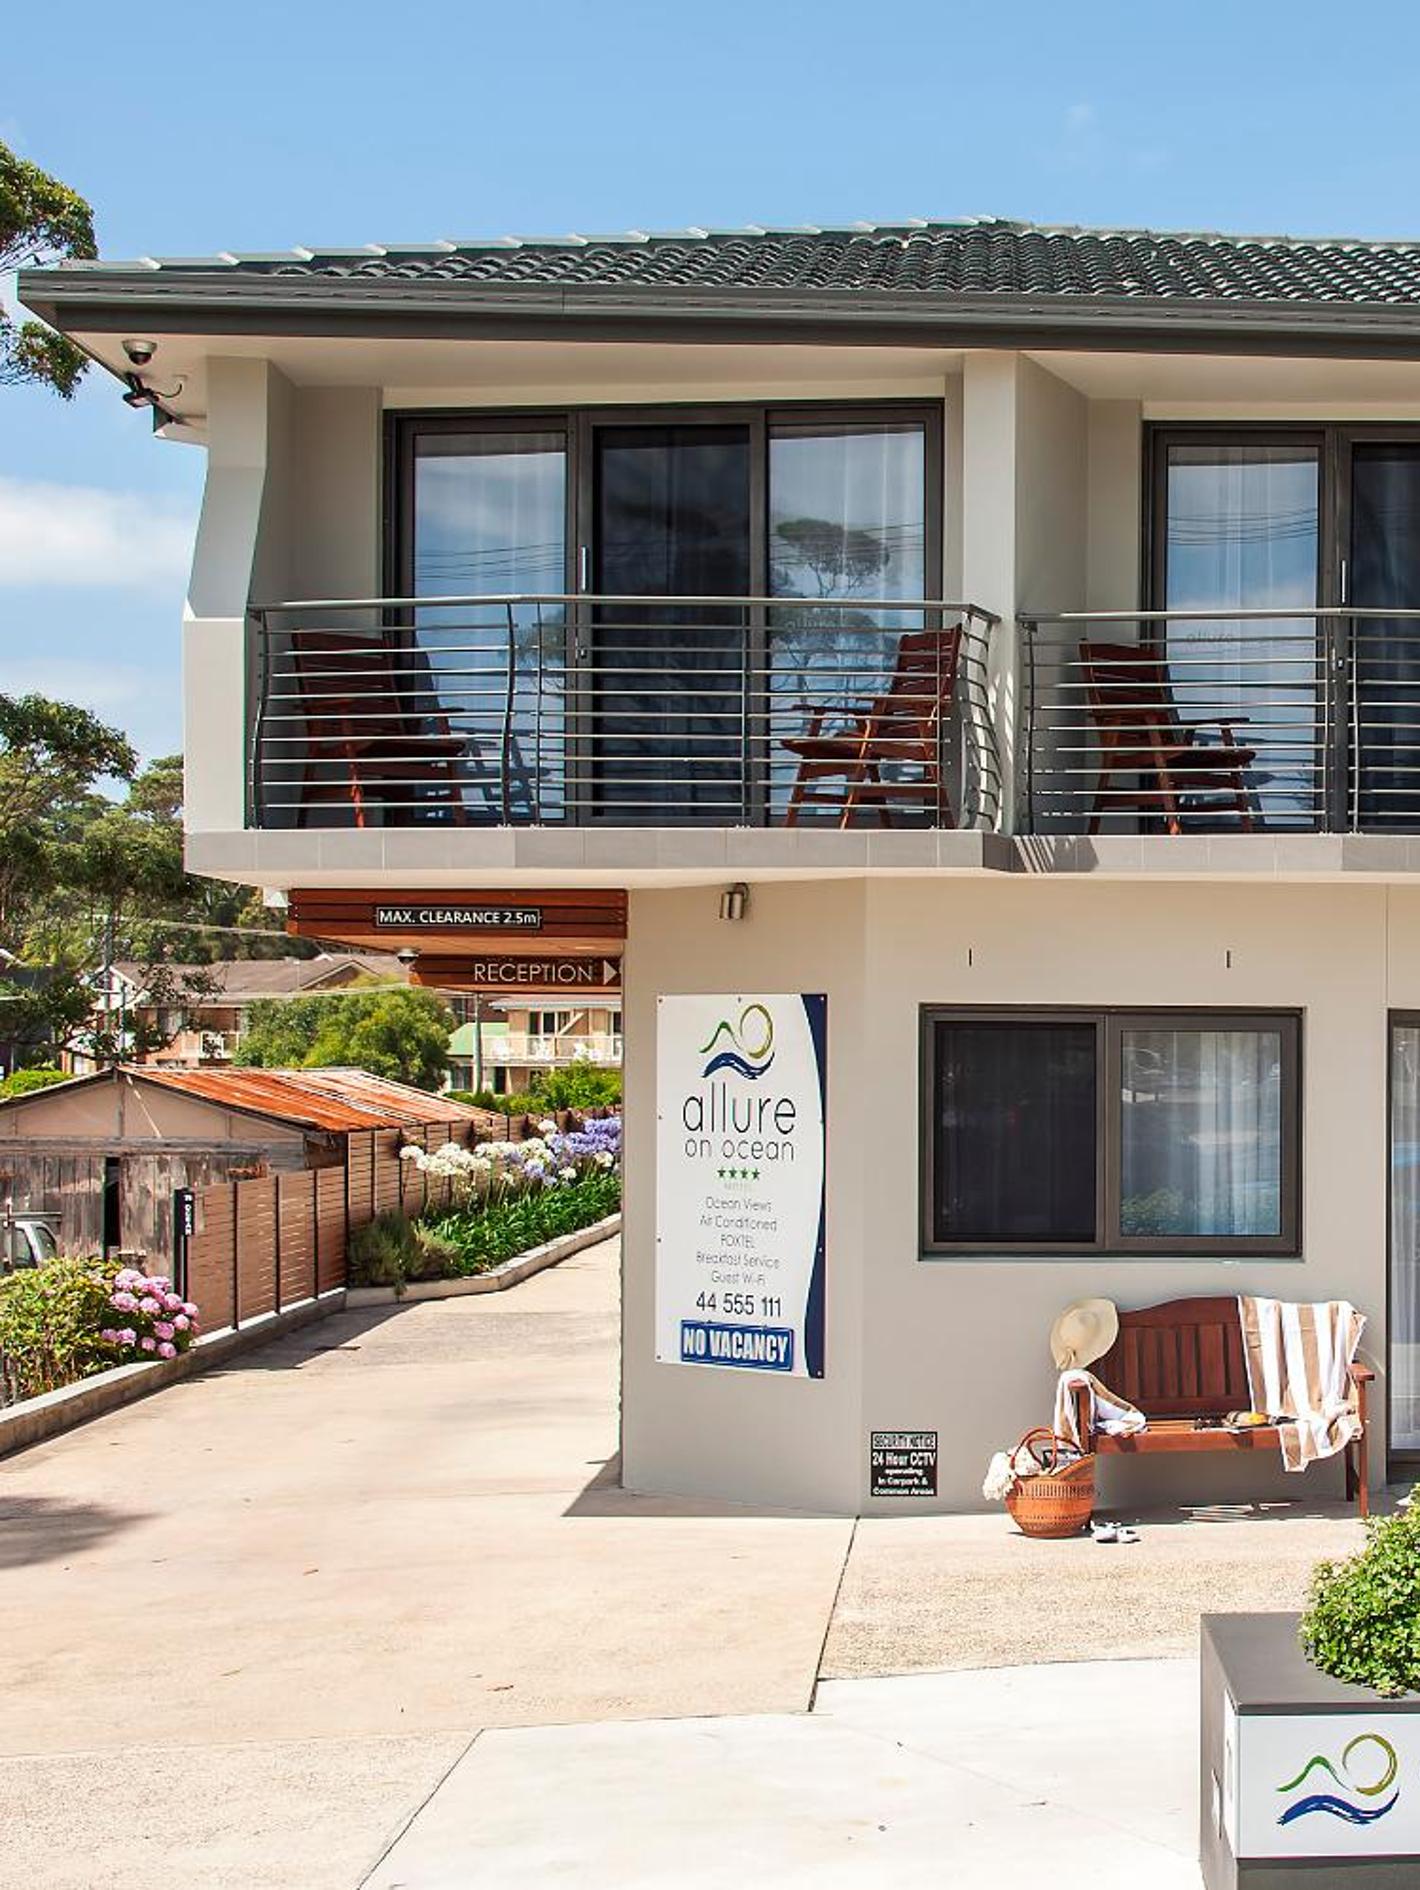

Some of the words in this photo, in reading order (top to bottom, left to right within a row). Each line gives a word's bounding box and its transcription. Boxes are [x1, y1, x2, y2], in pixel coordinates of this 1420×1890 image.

[379, 910, 416, 924] MAX.
[419, 910, 500, 924] CLEARANCE
[503, 912, 537, 925] 2.5m
[473, 963, 594, 984] RECEPTION
[682, 1081, 797, 1135] allure
[684, 1138, 713, 1158] on
[722, 1139, 795, 1161] ocean
[705, 1196, 741, 1210] Ocean
[744, 1198, 772, 1213] Views
[714, 1215, 778, 1232] Conditioned
[720, 1234, 755, 1249] FOXTEL
[696, 1251, 741, 1266] Breakfast
[743, 1254, 780, 1270] Service
[711, 1270, 740, 1284] Guest
[696, 1291, 717, 1311] 44
[722, 1293, 755, 1315] 555
[761, 1296, 782, 1317] 111
[683, 1327, 706, 1356] NO
[709, 1329, 788, 1363] VACANCY
[872, 1452, 884, 1466] 24
[910, 1452, 936, 1466] CCTV
